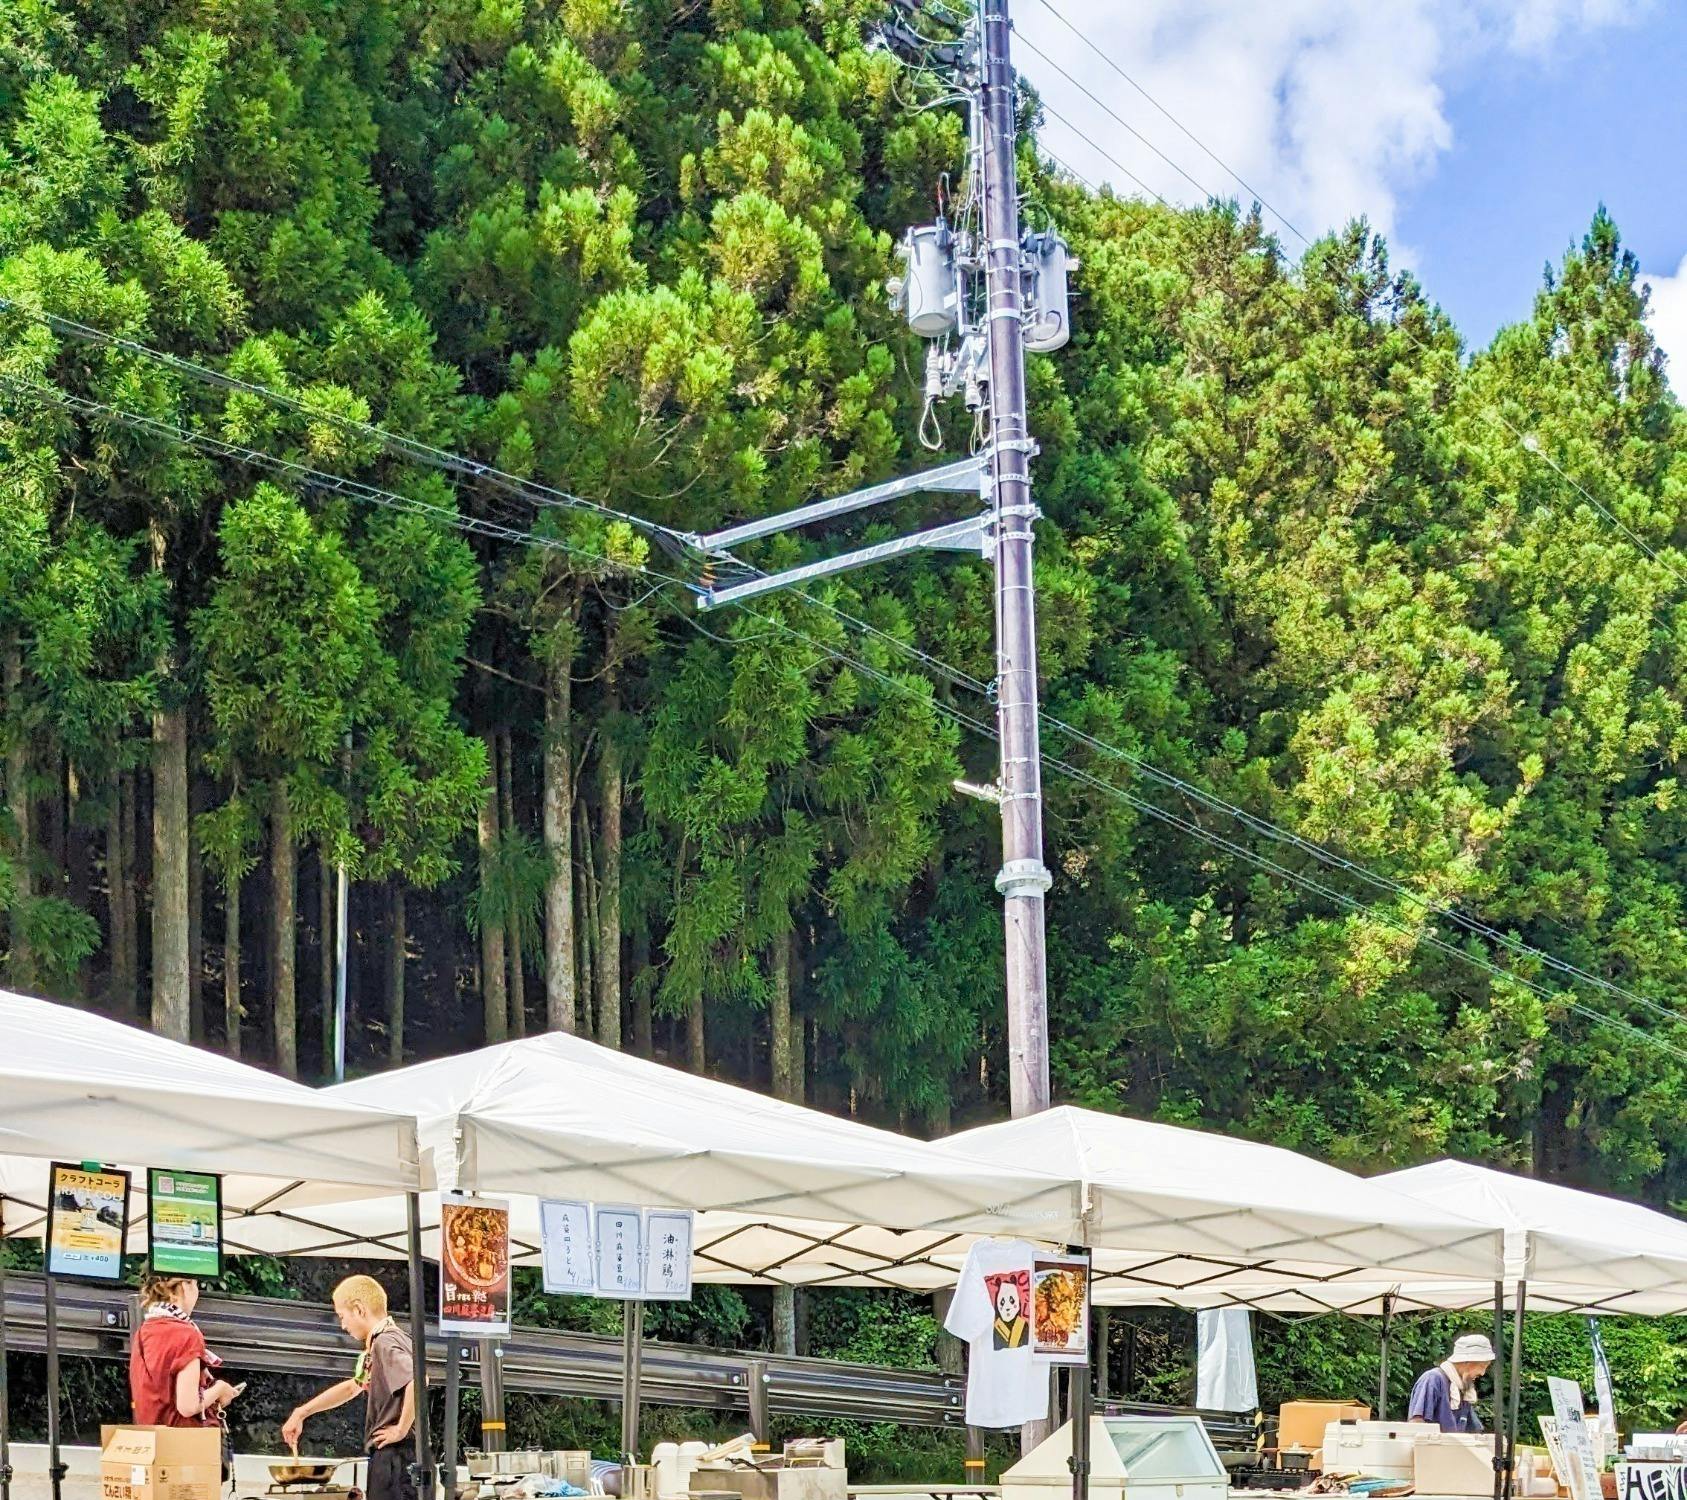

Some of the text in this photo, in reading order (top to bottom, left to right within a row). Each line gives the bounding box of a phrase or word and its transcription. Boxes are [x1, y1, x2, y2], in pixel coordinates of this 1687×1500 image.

[61, 1173, 121, 1188] クラフトコーラ
[662, 1233, 675, 1278] 油淋鶏
